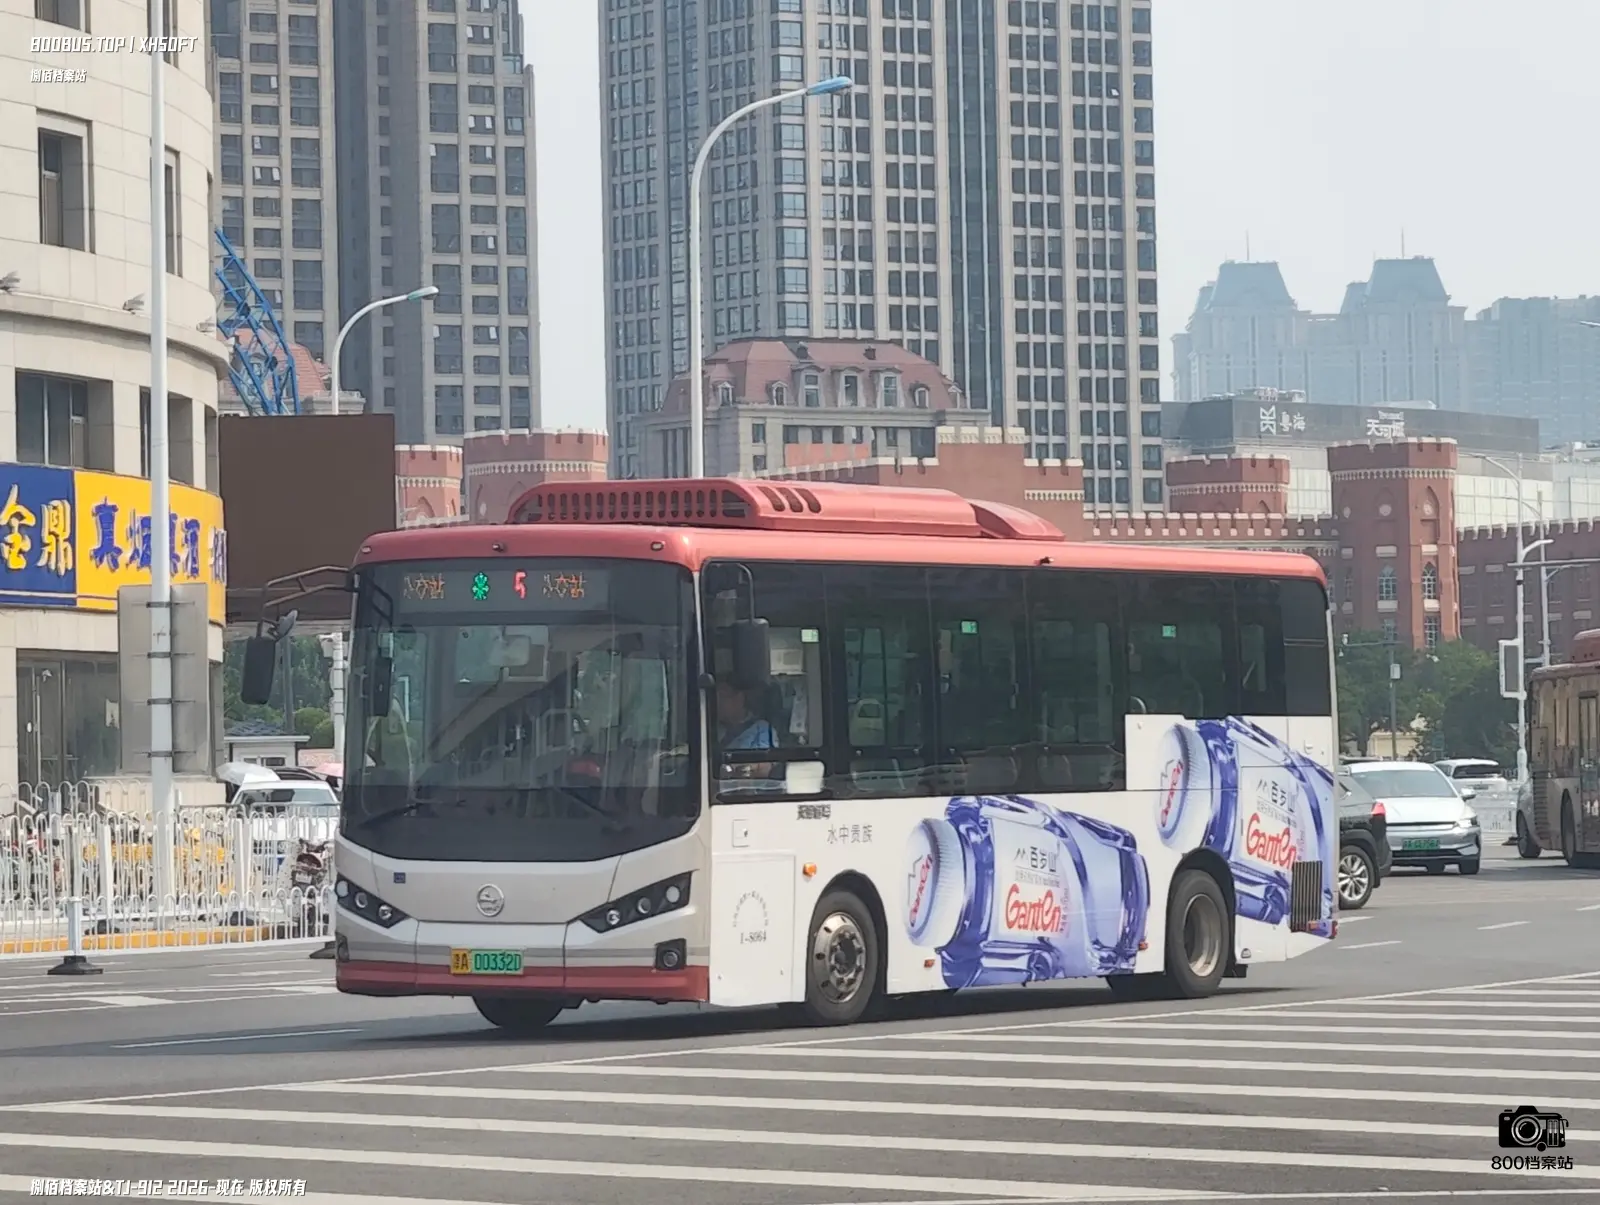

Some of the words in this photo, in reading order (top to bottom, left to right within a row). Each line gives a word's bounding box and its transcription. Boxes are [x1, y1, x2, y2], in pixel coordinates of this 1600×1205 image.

[0, 483, 73, 577] 金鼎
[826, 823, 873, 845] 水中贵族
